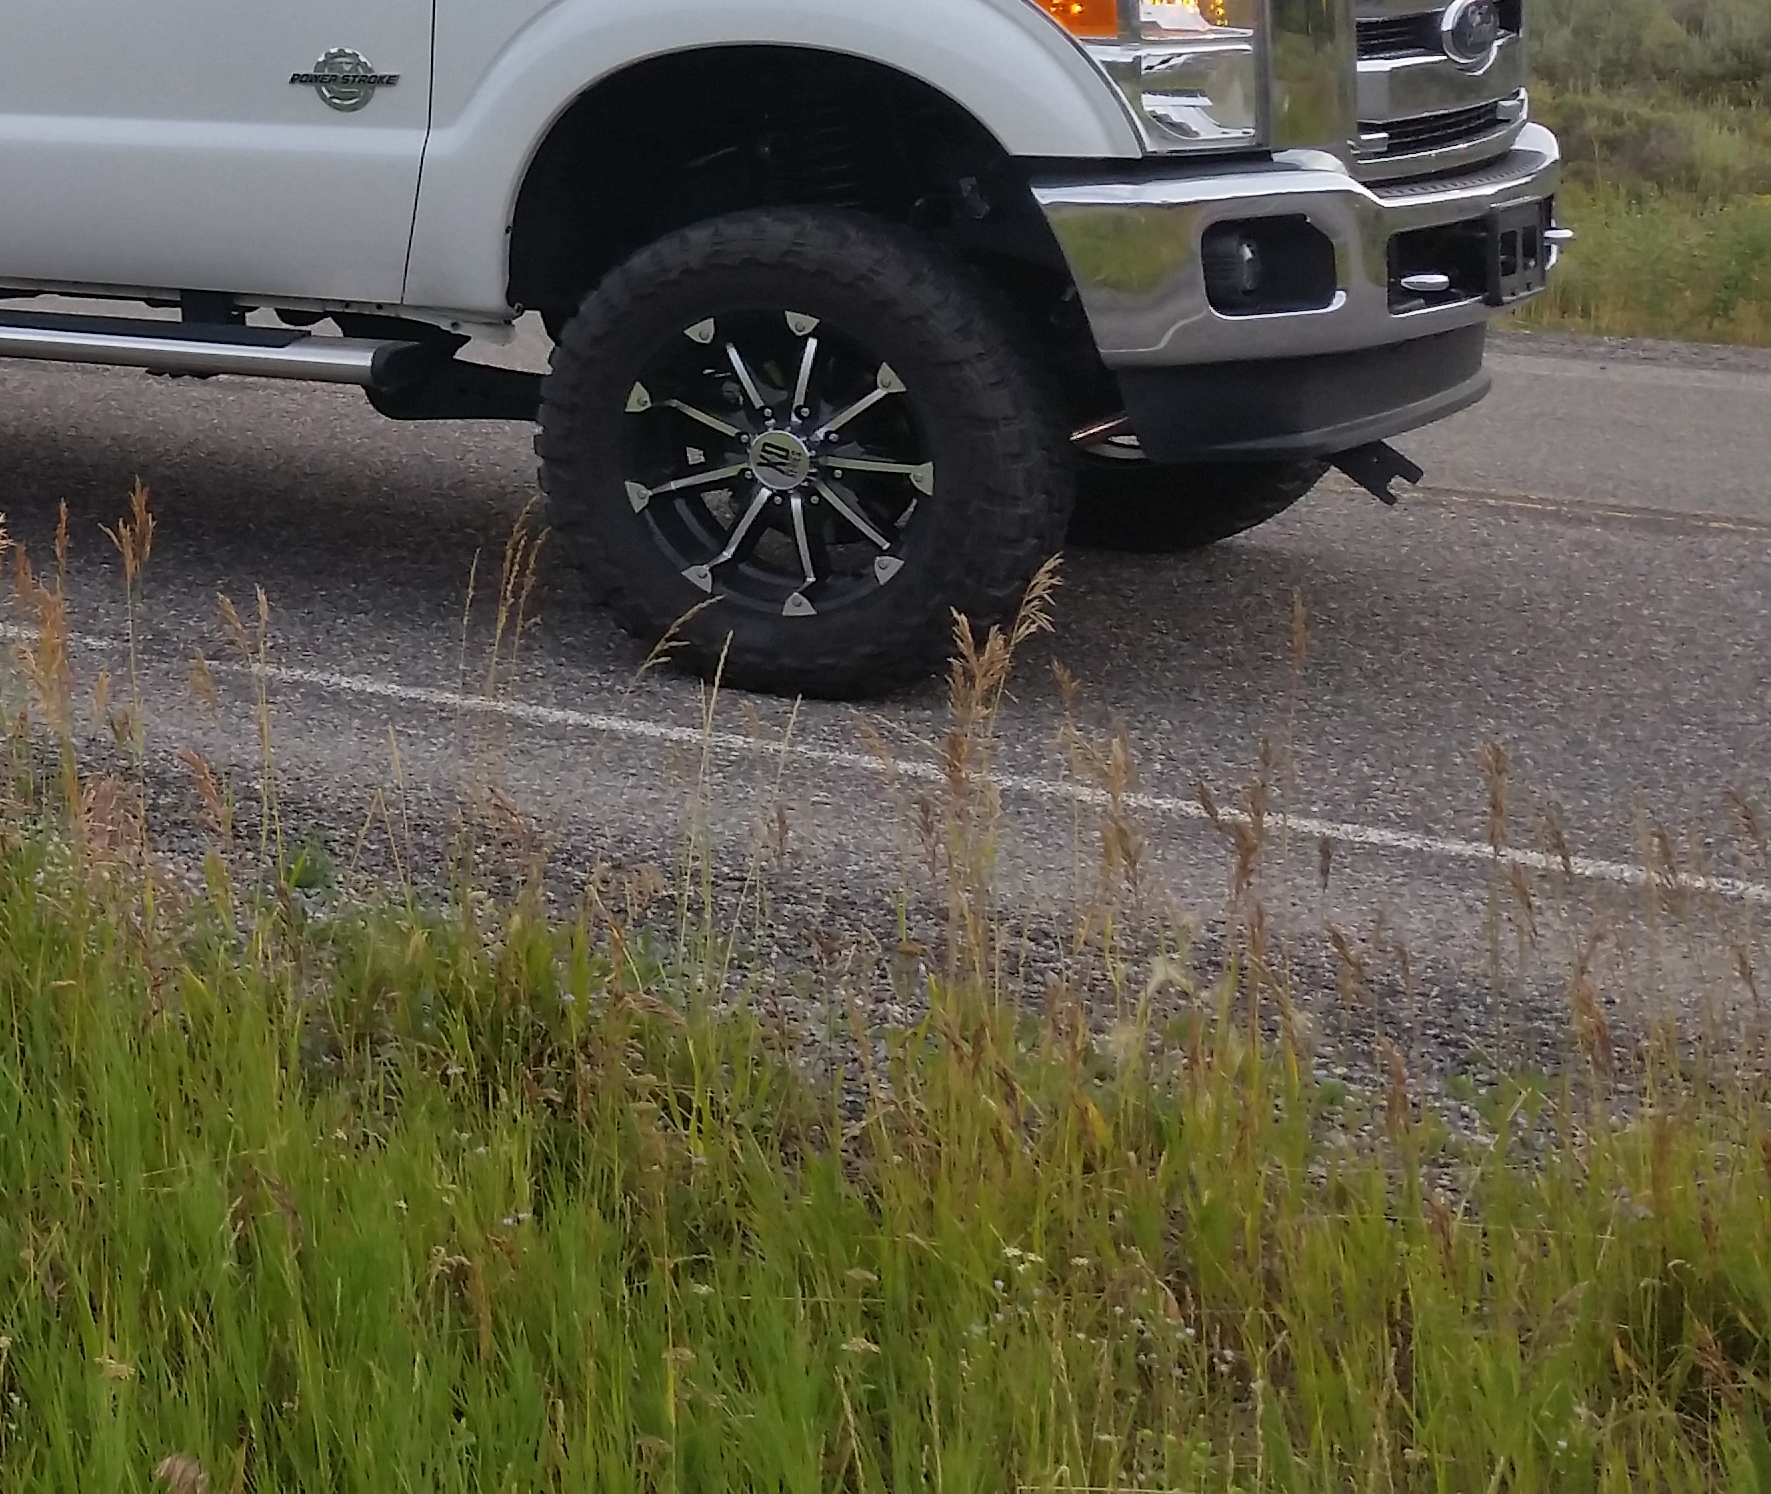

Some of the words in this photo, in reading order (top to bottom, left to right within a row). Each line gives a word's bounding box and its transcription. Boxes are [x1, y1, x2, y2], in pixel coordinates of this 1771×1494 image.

[289, 73, 338, 85] POWER
[339, 74, 397, 86] STROKE
[756, 441, 791, 476] XD
